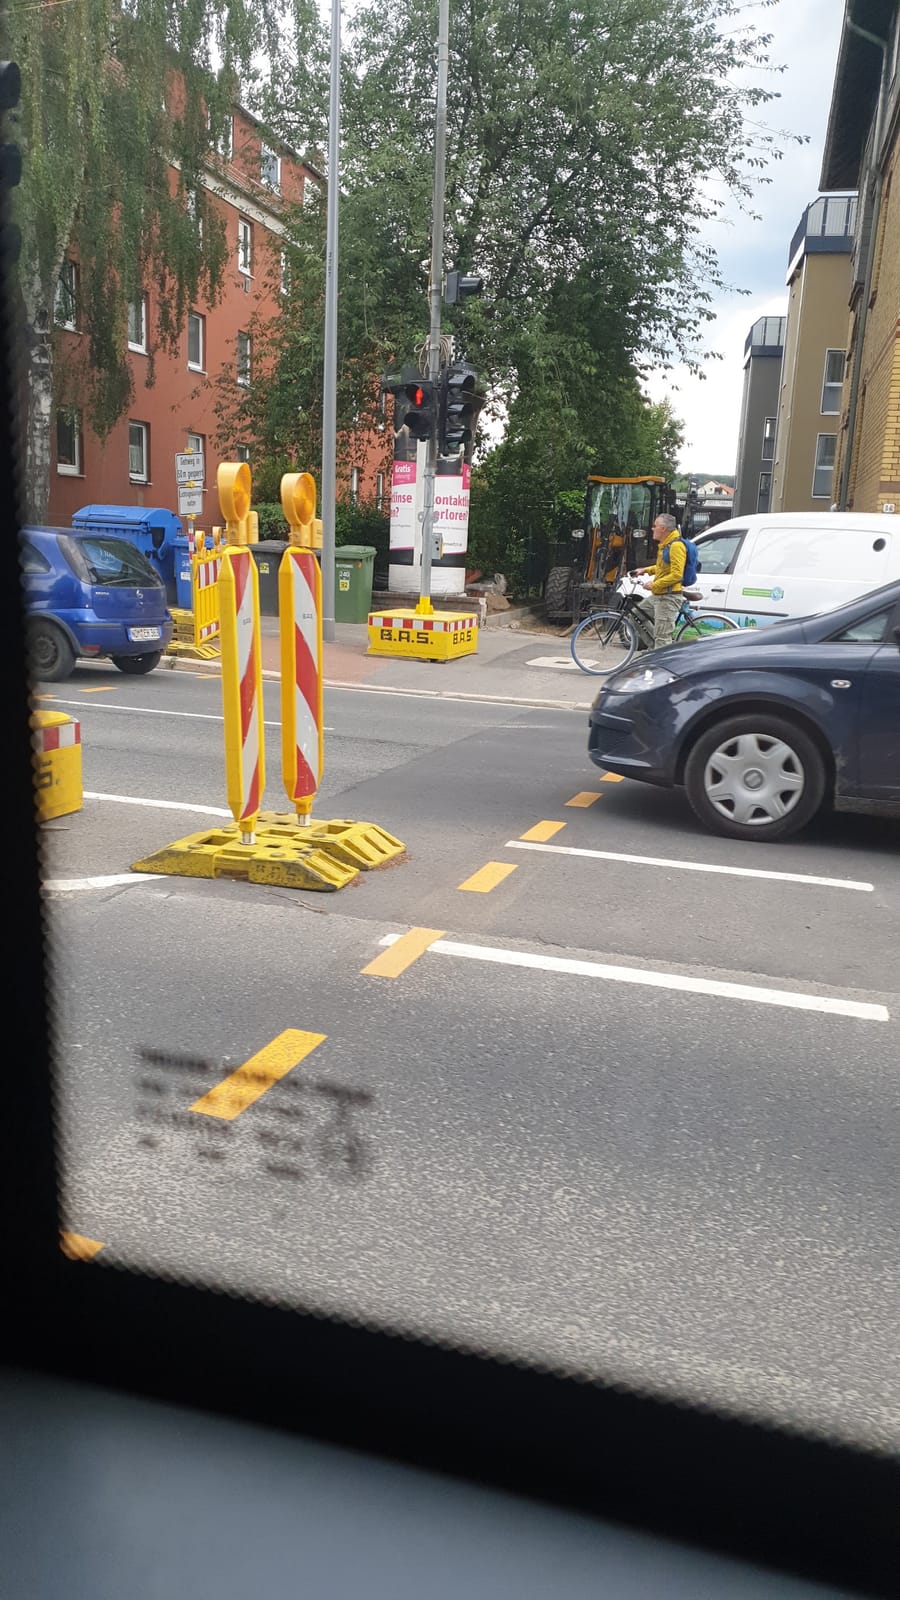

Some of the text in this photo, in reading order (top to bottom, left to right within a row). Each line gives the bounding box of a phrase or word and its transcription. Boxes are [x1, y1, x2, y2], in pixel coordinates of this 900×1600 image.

[395, 464, 411, 473] Gratis
[381, 628, 434, 645] B.A.S.
[453, 630, 474, 645] B.A.S.
